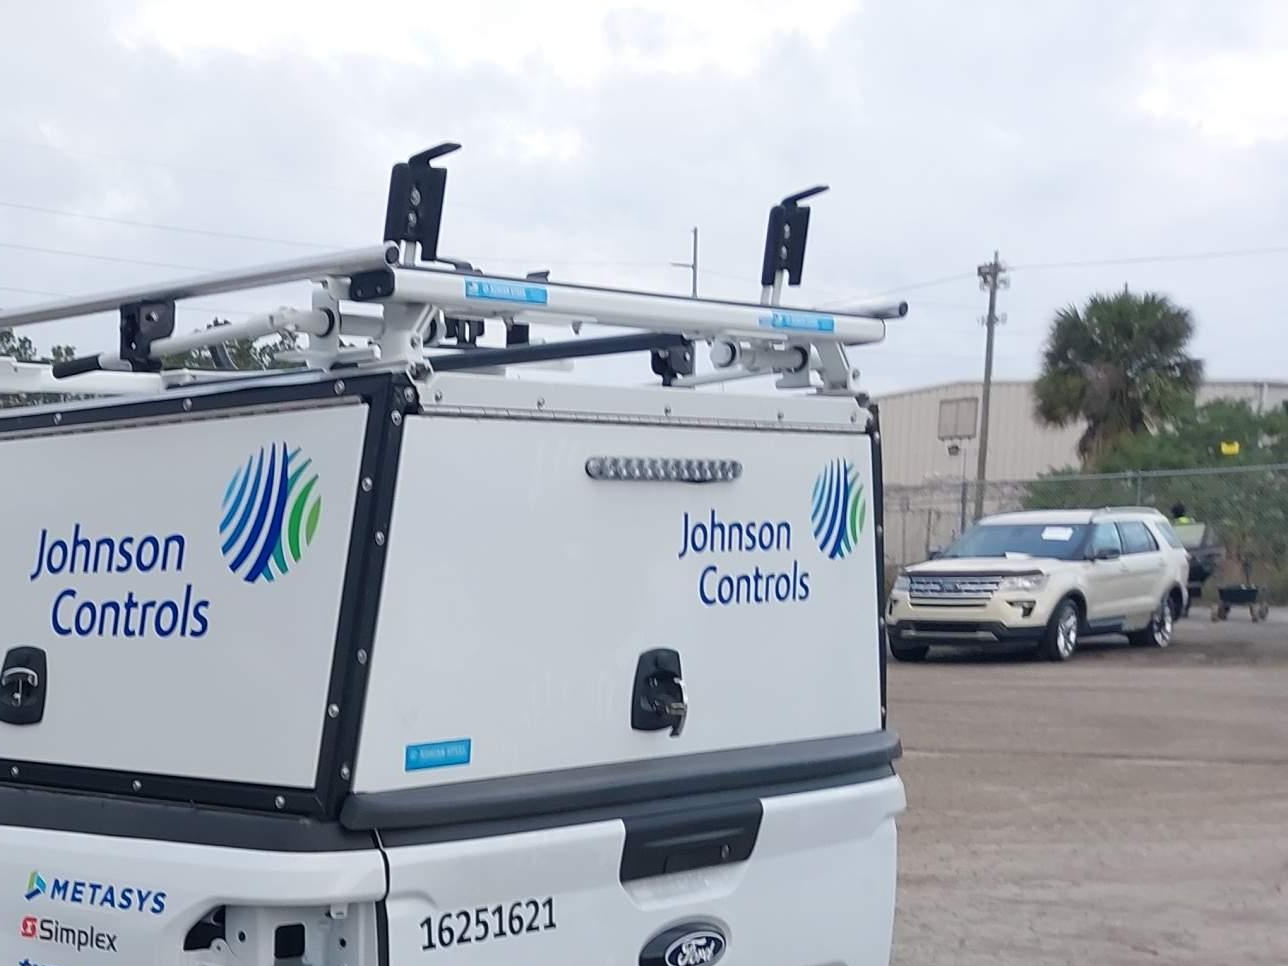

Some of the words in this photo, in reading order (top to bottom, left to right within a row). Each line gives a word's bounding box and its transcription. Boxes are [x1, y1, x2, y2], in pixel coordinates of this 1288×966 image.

[30, 524, 186, 581] Johnson
[678, 510, 791, 558] Johnson
[699, 560, 810, 605] Controls
[51, 584, 210, 638] Controls
[50, 878, 167, 914] METASYS
[39, 919, 117, 952] Simplex
[420, 897, 557, 950] 16251621
